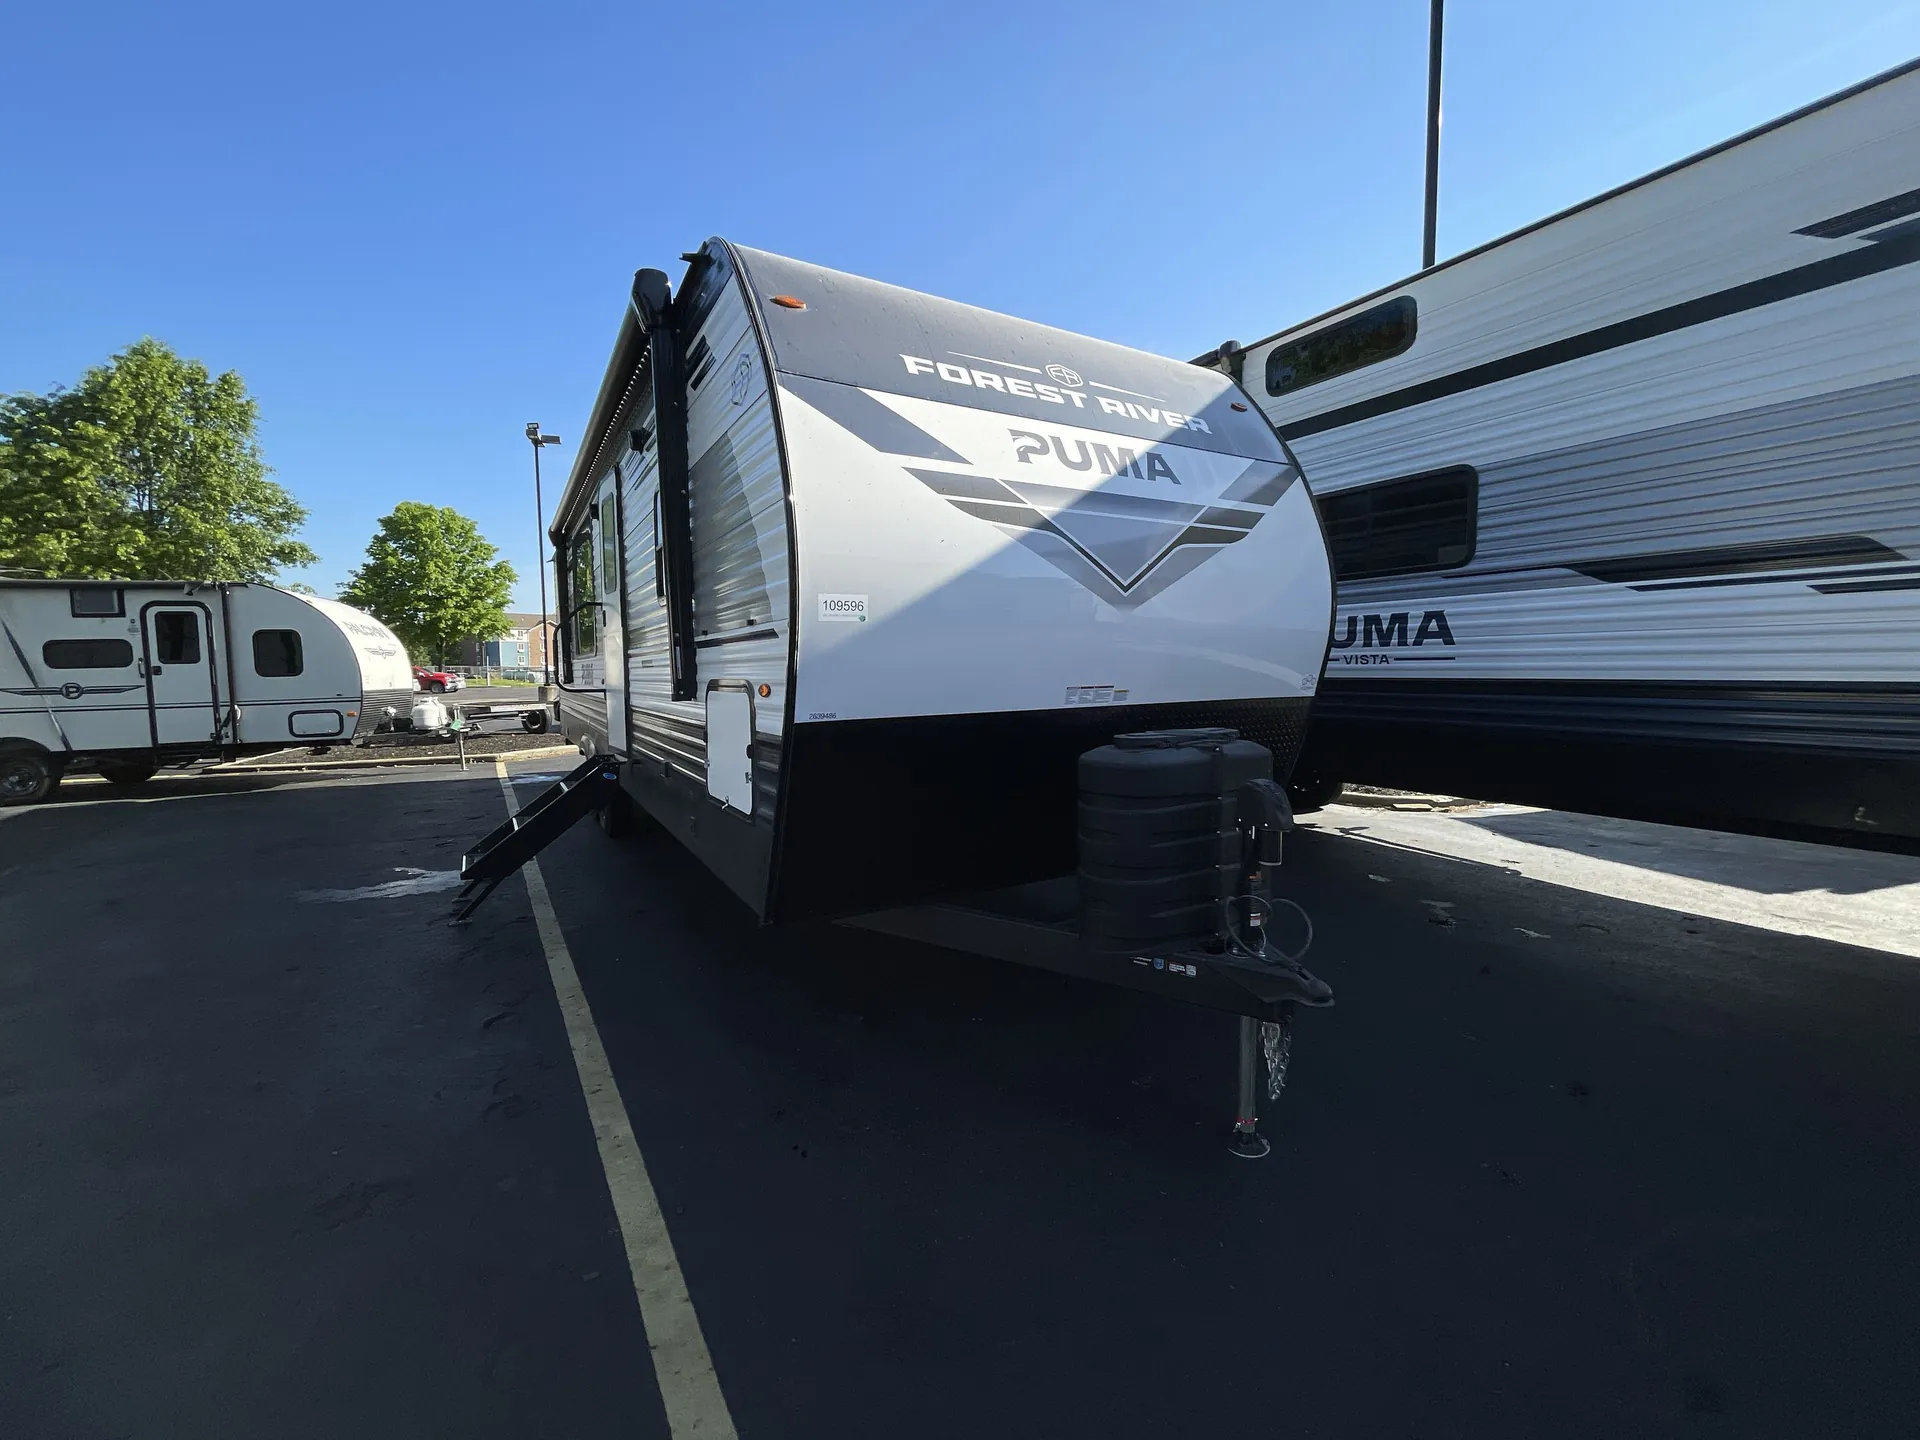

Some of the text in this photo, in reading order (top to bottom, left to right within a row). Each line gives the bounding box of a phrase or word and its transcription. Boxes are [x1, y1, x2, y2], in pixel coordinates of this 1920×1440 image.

[899, 353, 1213, 435] FOREST RIVER
[1007, 428, 1182, 486] PUMA
[822, 599, 865, 612] 109596
[1331, 610, 1456, 649] UMA
[1342, 654, 1391, 665] VISTA
